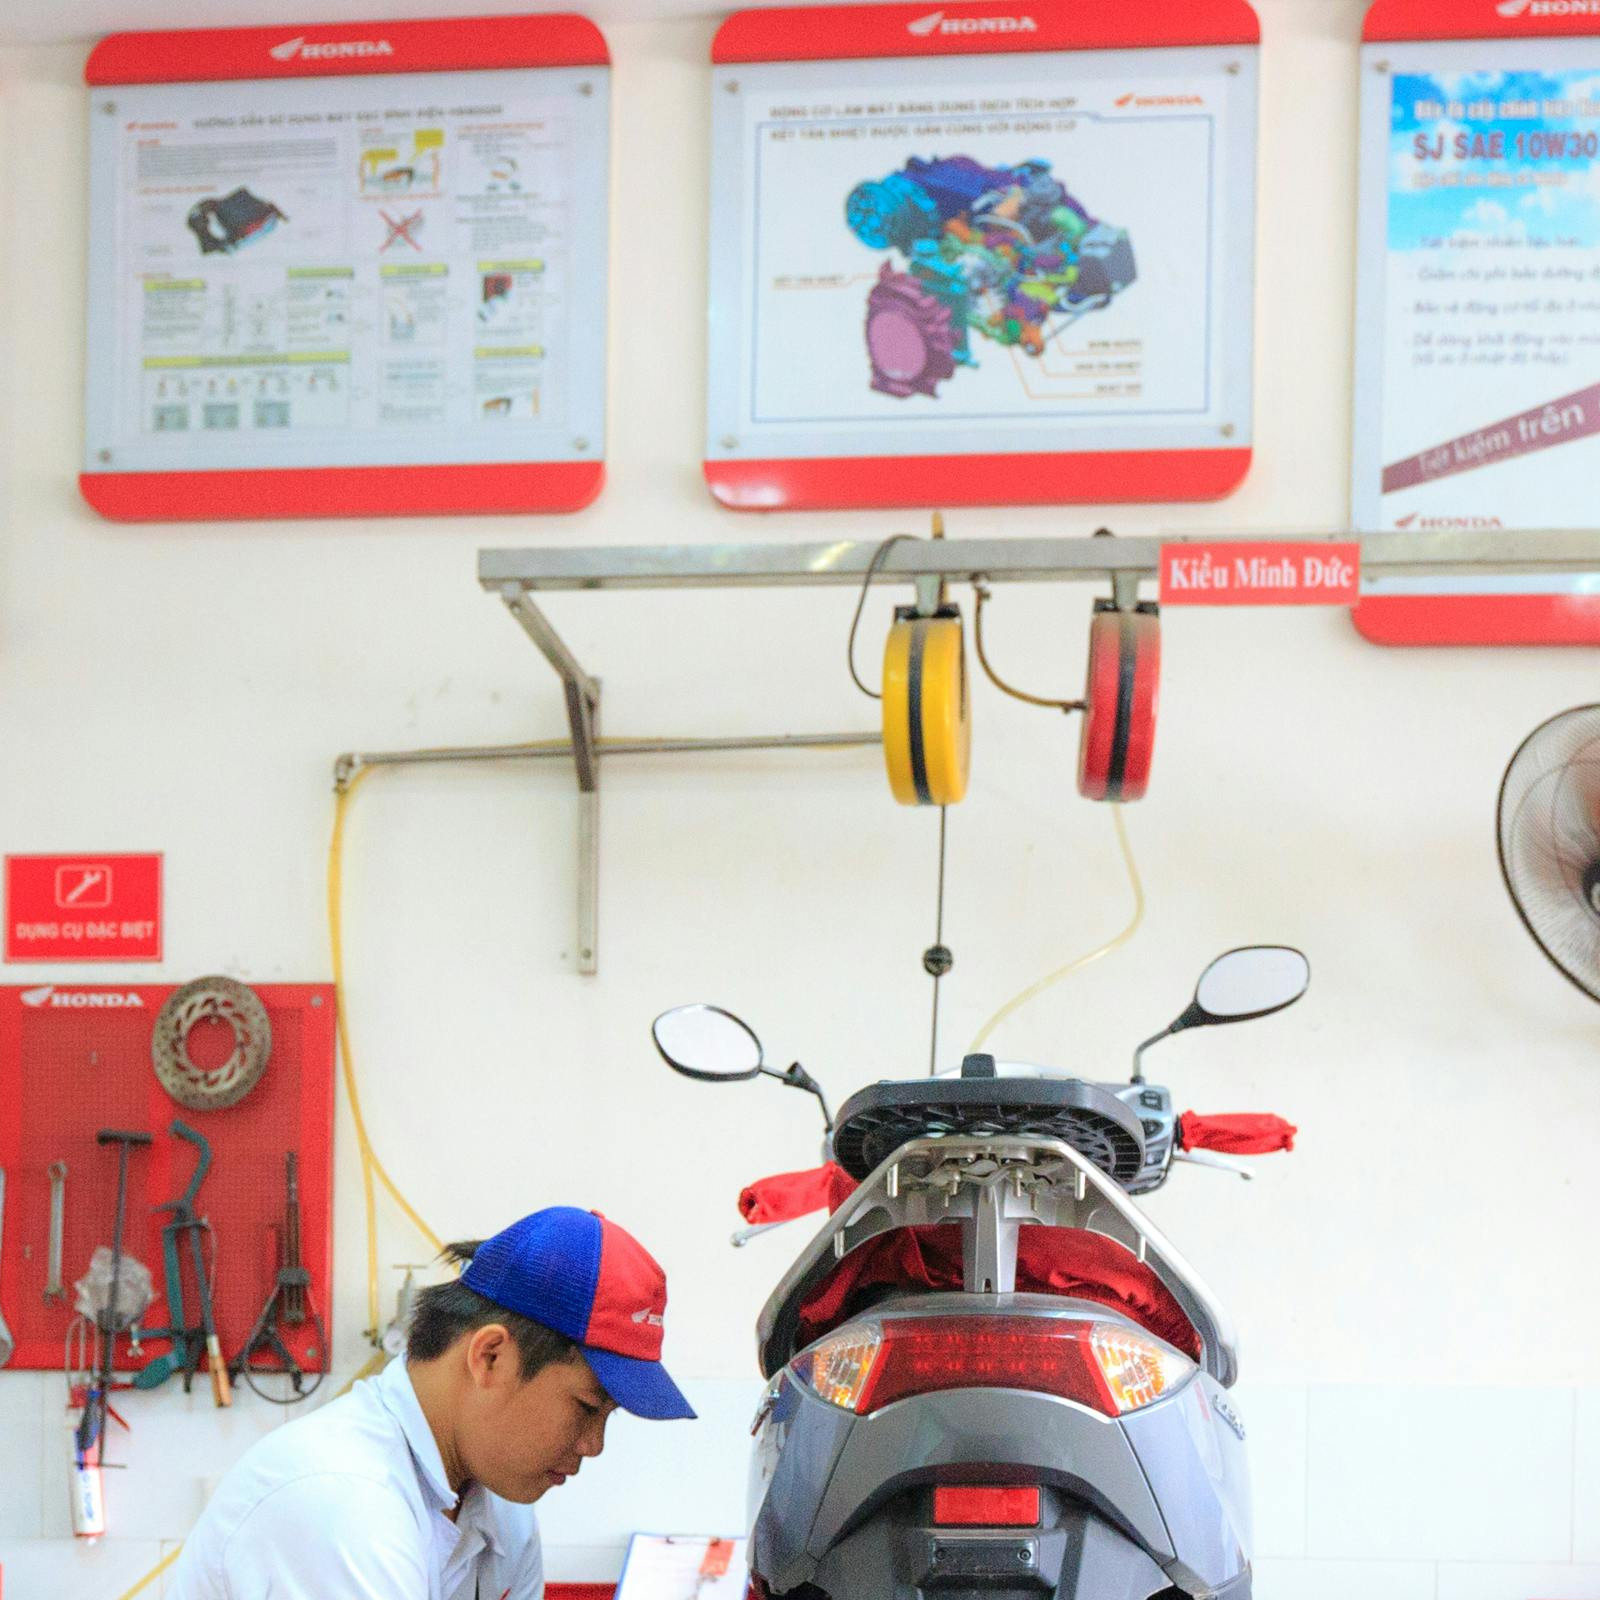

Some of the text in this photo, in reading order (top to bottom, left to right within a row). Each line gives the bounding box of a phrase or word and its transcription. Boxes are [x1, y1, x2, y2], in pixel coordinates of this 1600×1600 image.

[941, 17, 1037, 34] HONDA
[303, 40, 392, 58] HONDA
[1413, 131, 1444, 160] SJ
[1453, 131, 1504, 160] SAE
[1516, 130, 1598, 159] 10W30
[1453, 428, 1511, 464] kiệm
[1518, 406, 1585, 444] trên
[1420, 516, 1503, 529] HONDA
[1234, 556, 1297, 589] Minh
[1303, 555, 1354, 588] Đức
[52, 992, 144, 1007] HONDA
